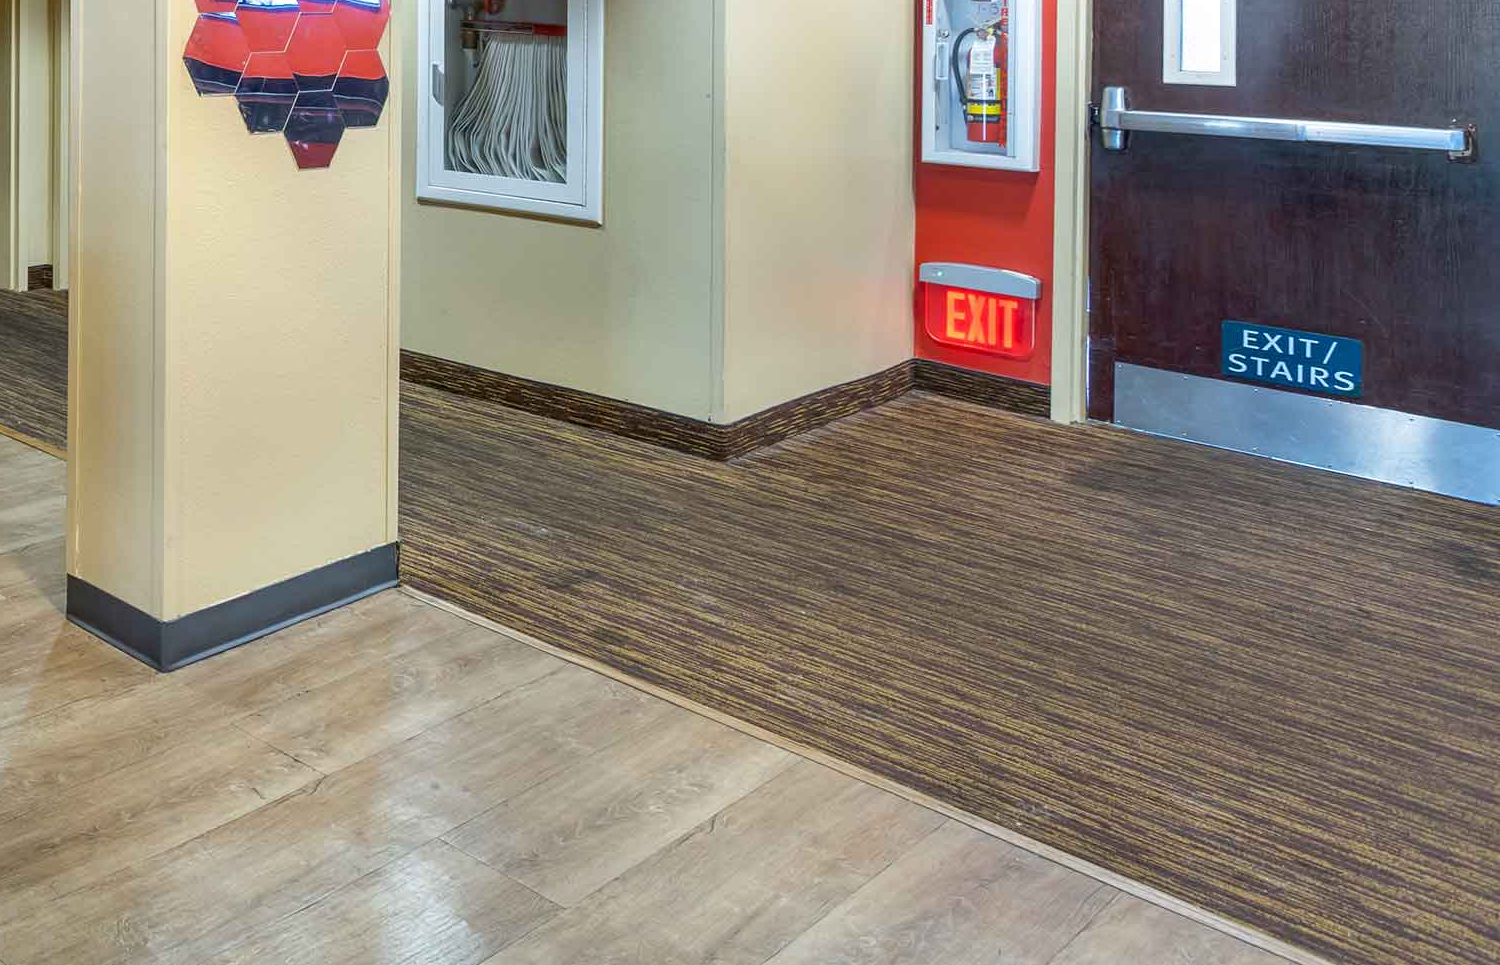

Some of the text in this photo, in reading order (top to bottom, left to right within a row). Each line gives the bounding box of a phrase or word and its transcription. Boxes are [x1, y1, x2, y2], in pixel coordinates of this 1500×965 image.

[946, 290, 1019, 349] EXIT
[1243, 329, 1338, 365] EXIT/
[1228, 353, 1355, 392] STAIRS
